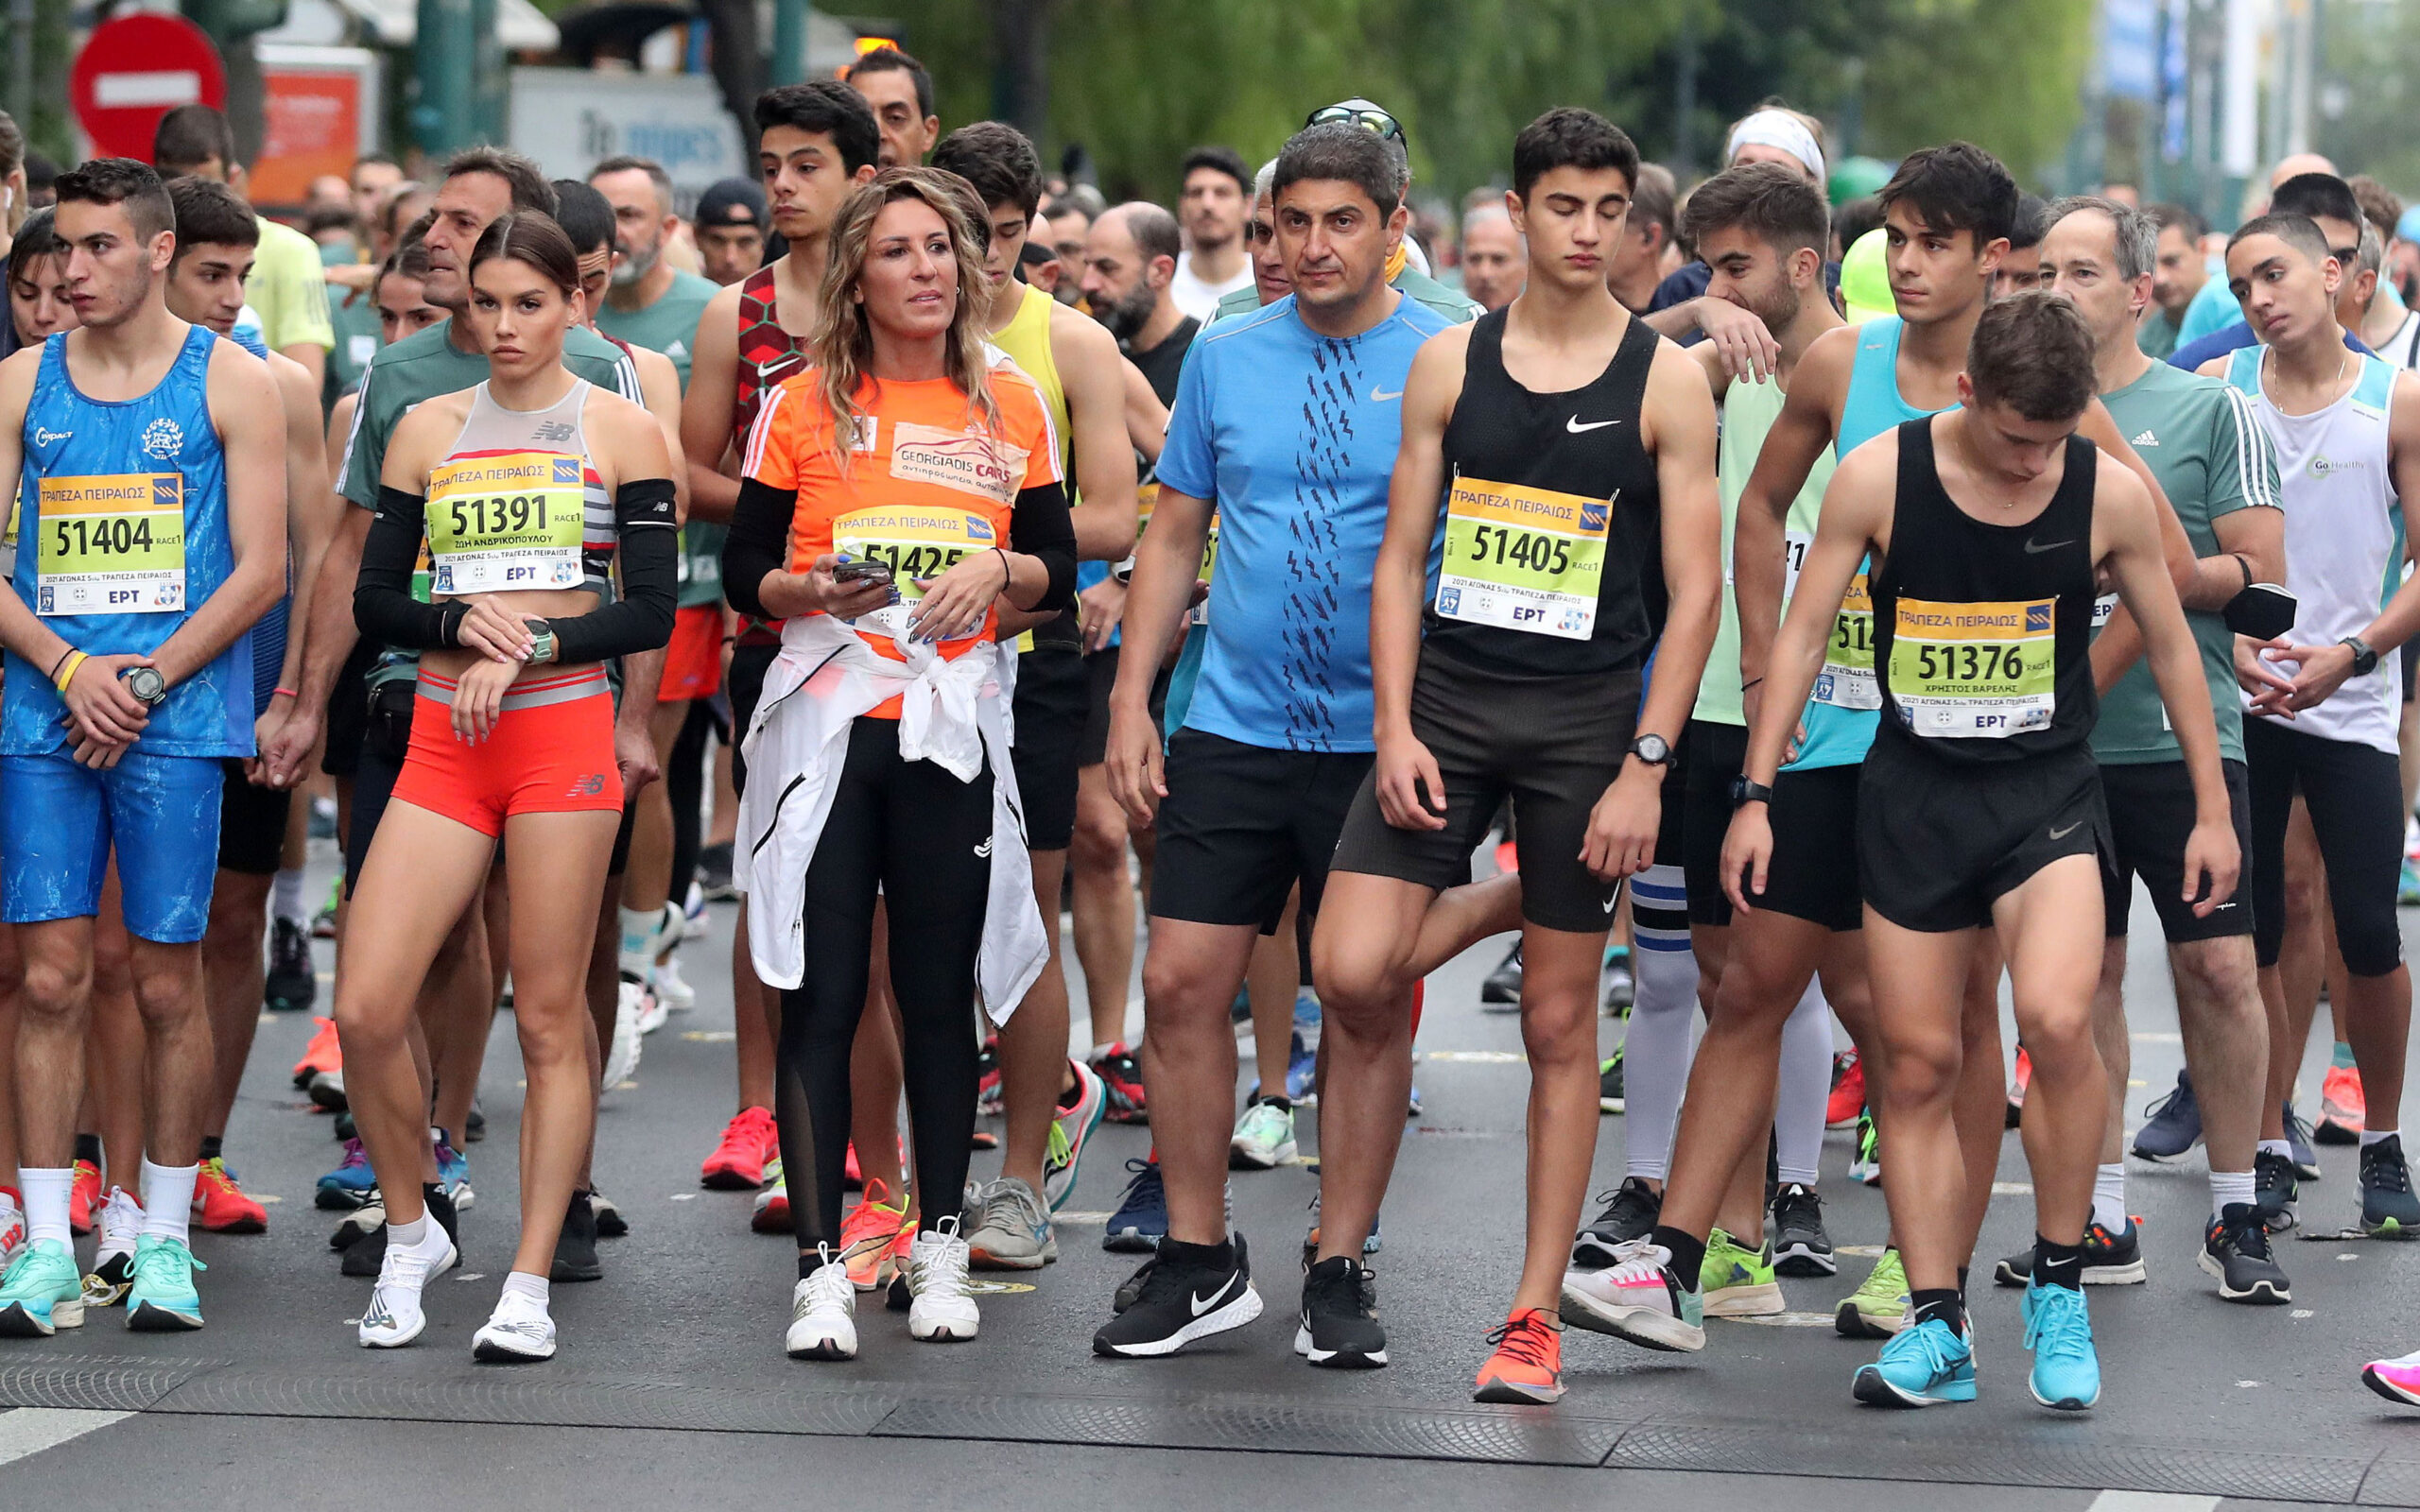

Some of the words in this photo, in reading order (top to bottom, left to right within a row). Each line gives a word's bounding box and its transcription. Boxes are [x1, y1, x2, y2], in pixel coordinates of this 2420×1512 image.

[2132, 438, 2159, 447] adidas
[902, 450, 974, 472] GEORGIADIS
[976, 464, 1011, 484] CARS
[2331, 461, 2365, 470] Healthy
[432, 469, 482, 492] ΤΡΑΠΕΖΑ
[486, 465, 545, 480] ΠΕΙΡΑΙΩΣ
[42, 489, 82, 503] ΤΡΑΠΕΖΑ
[85, 487, 146, 501] ΠΕΙΡΑΙΩΣ
[1453, 489, 1511, 509] ΤΡΑΠΕΖΑ
[1513, 499, 1573, 520] ΠΕΙΡΑΙΩΣ
[452, 495, 545, 536] 51391
[838, 517, 897, 530] ΤΡΑΠΕΖΑ
[900, 517, 959, 530] ΠΕΙΡΑΙΩΣ
[57, 518, 153, 557] 51404
[455, 539, 471, 549] ΖΩΗ
[474, 535, 553, 547] ΑΝΔΡΙΚΟΠΟΥΛΟΥ
[456, 553, 486, 562] ΑΓΩΝΑΣ
[1471, 525, 1571, 575] 51405
[58, 575, 86, 583] ΑΓΩΝΑΣ
[101, 573, 135, 581] ΤΡΑΠΕΖΑ
[137, 571, 173, 580] ΠΕΙΡΑΙΩΣ
[506, 567, 536, 581] ΕΡΤ
[109, 590, 140, 604] ΕΡΤ
[1468, 581, 1495, 592] ΑΓΩΝΑΣ
[1512, 588, 1545, 600] ΤΡΑΠΕΖΑ
[1547, 593, 1582, 604] ΠΕΙΡΑΙΩΣ
[1512, 606, 1546, 623] ΕΡΤ
[1899, 610, 1952, 627] ΤΡΑΠΕΖΑ
[1956, 615, 2018, 627] ΠΕΙΡΑΙΩΣ
[1918, 644, 2023, 680] 51376
[2005, 696, 2039, 705] ΠΕΙΡΑΙΩΣ
[1976, 714, 2008, 728] ΕΡΤ
